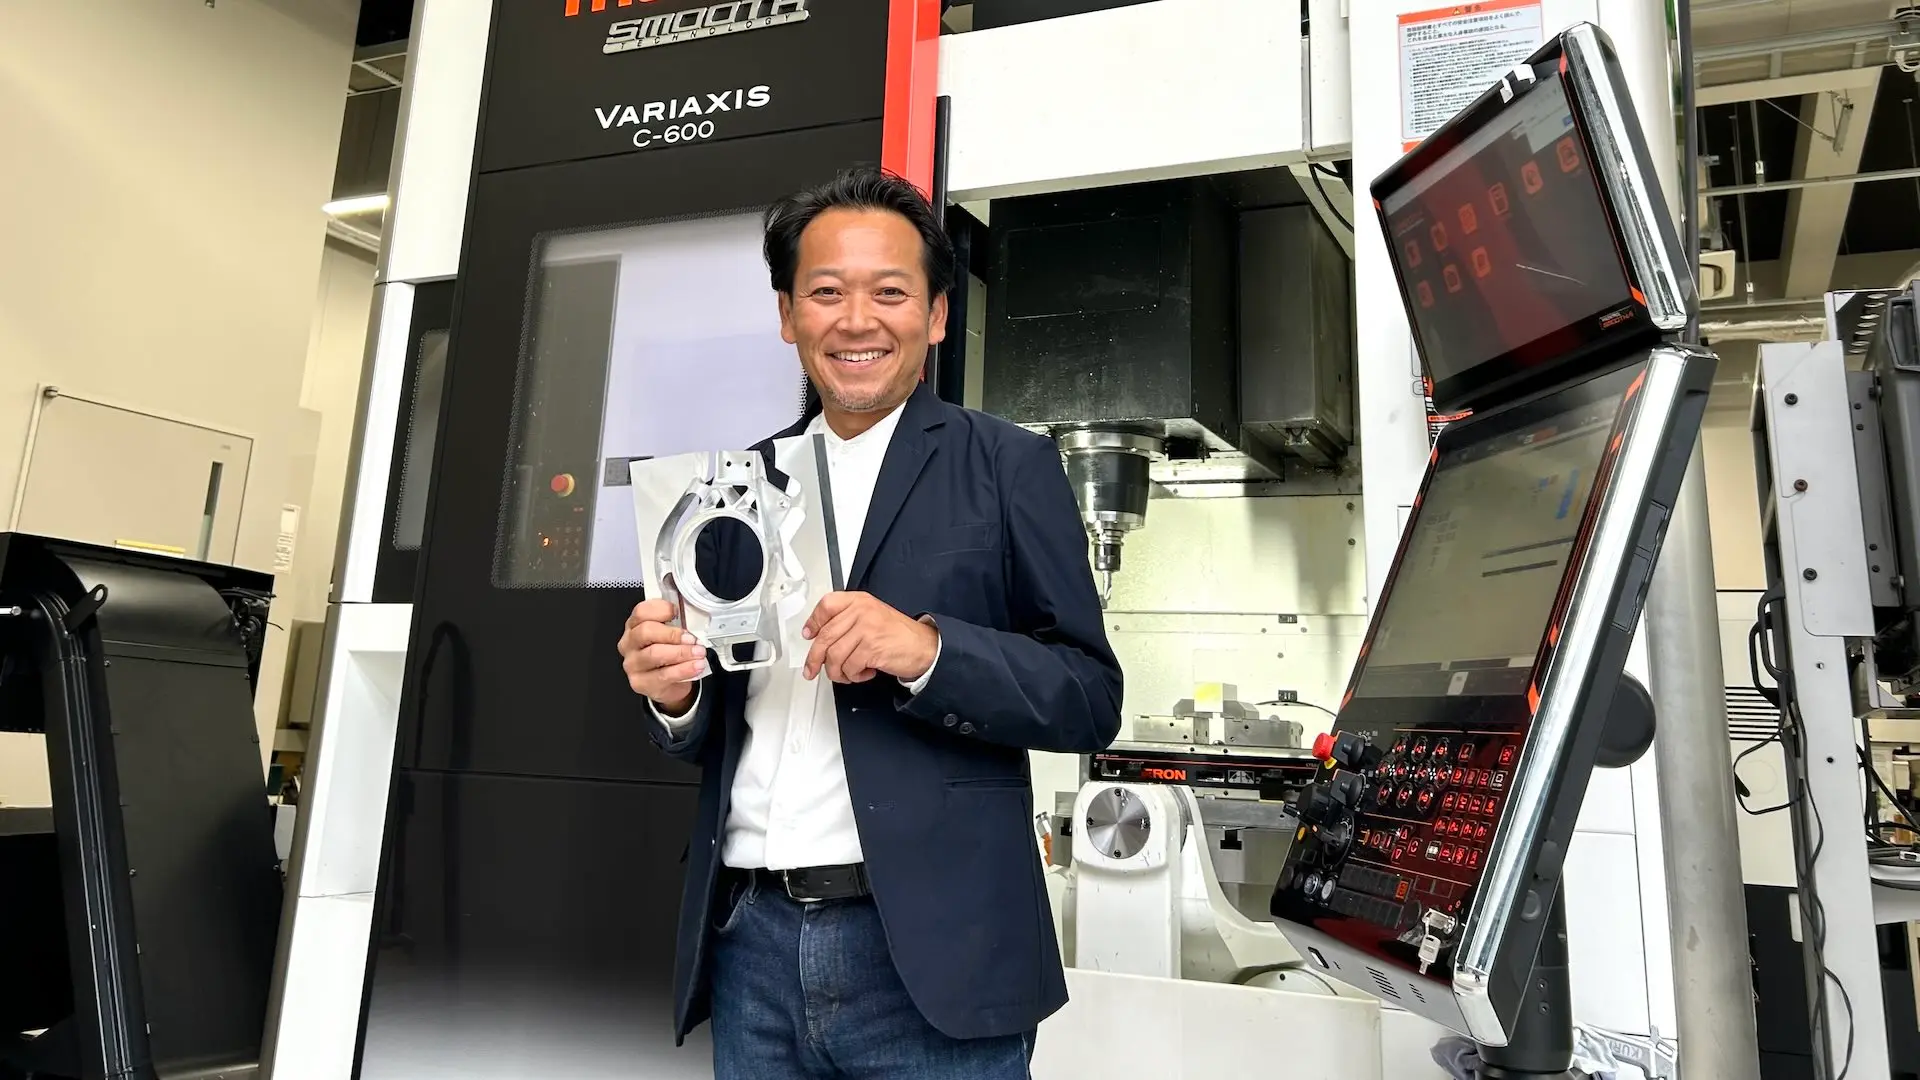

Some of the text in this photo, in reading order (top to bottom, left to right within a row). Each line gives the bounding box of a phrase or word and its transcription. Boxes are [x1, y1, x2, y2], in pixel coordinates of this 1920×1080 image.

[606, 0, 806, 44] SMOOTH
[620, 14, 792, 50] TECHNOLOGY
[594, 84, 772, 130] VARIAXIS
[632, 120, 715, 148] C-600
